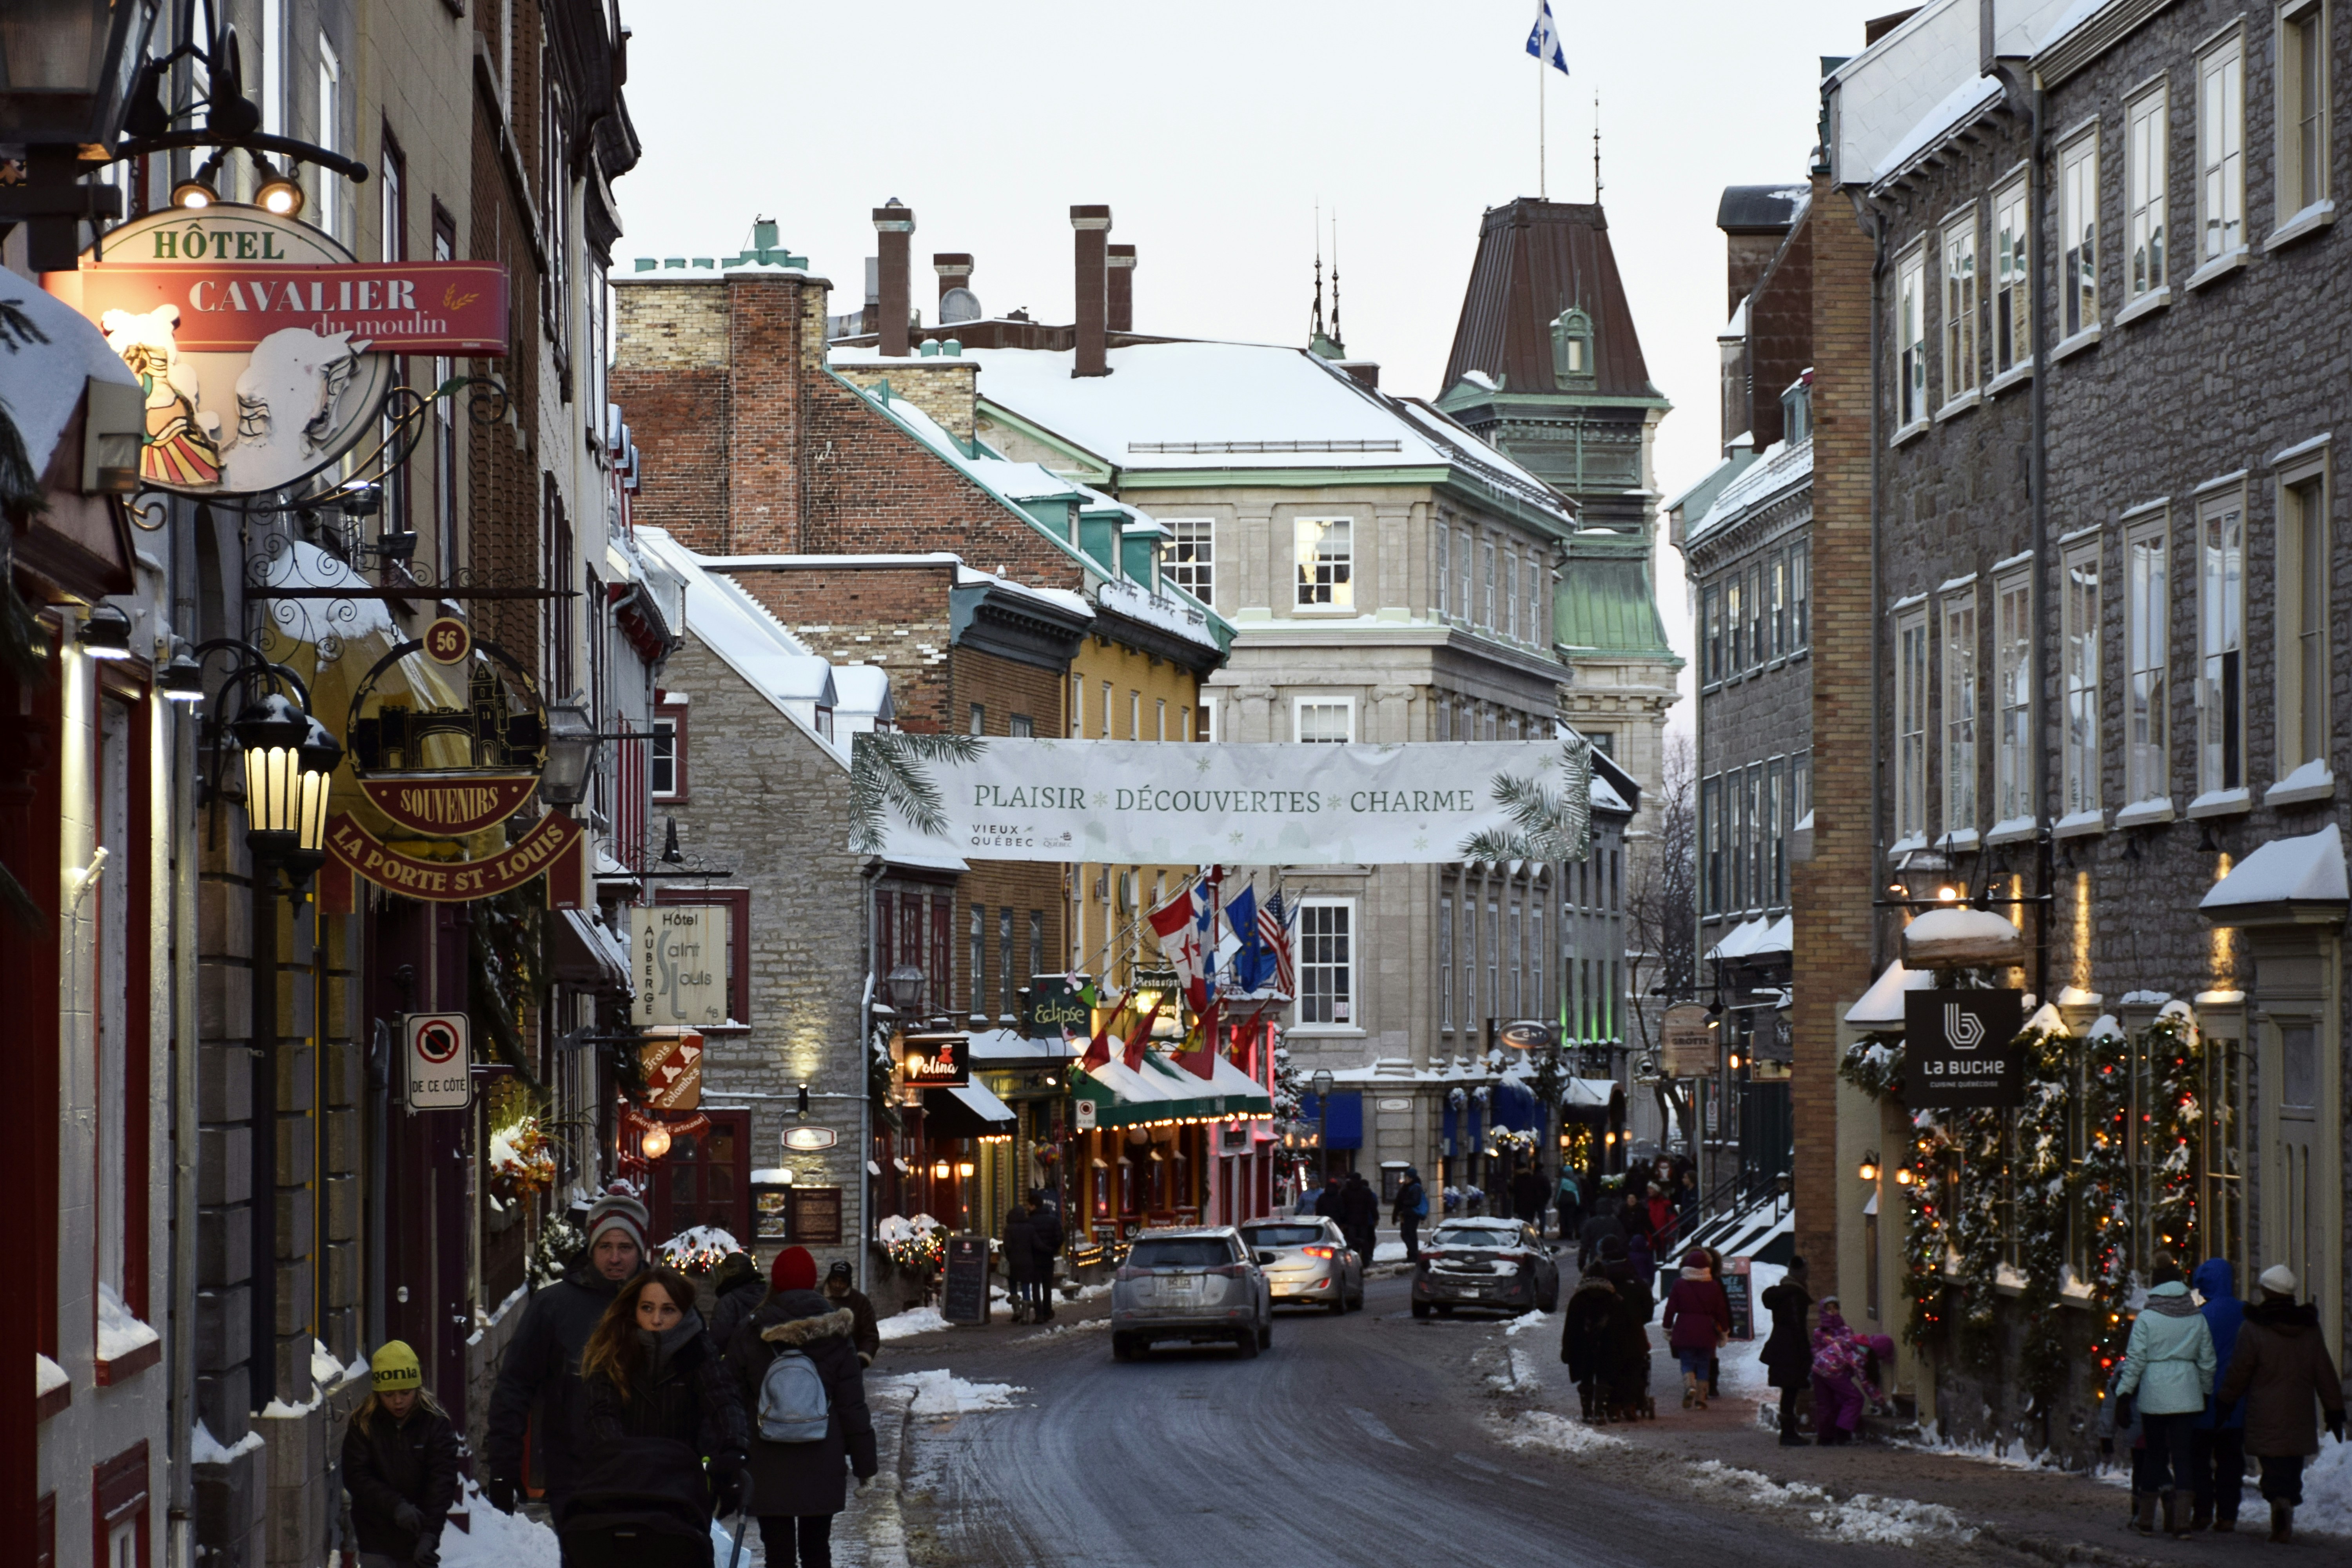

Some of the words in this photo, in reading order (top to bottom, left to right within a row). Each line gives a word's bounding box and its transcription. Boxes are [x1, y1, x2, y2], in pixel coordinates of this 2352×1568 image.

[153, 223, 284, 260] HÔTEL
[189, 279, 417, 312] CAVALIER
[311, 313, 346, 336] du
[356, 310, 447, 335] moulin
[436, 630, 457, 652] 56
[400, 787, 499, 824] SOUVENIRS
[974, 785, 1087, 809] PLAISIR
[1116, 784, 1320, 813] DÉCOUVERTES
[1350, 790, 1474, 813] CHARME
[971, 835, 1033, 847] QUÉBEC
[972, 824, 1018, 834] VIEUX
[333, 825, 359, 858] LA
[364, 849, 446, 892] PORTE
[662, 913, 698, 926] Hôtel
[644, 926, 654, 1014] AUBERGE
[657, 930, 700, 996] Saint
[671, 962, 712, 1019] Louis
[1034, 998, 1085, 1029] Eclipse
[643, 1044, 670, 1071] Trois
[909, 1055, 959, 1080] Polina
[412, 1080, 424, 1093] DE
[428, 1080, 439, 1092] CE
[443, 1078, 466, 1092] CÔTÉ
[662, 1068, 700, 1108] Colombes
[629, 1113, 652, 1129] galeri
[372, 1367, 417, 1383] gonia
